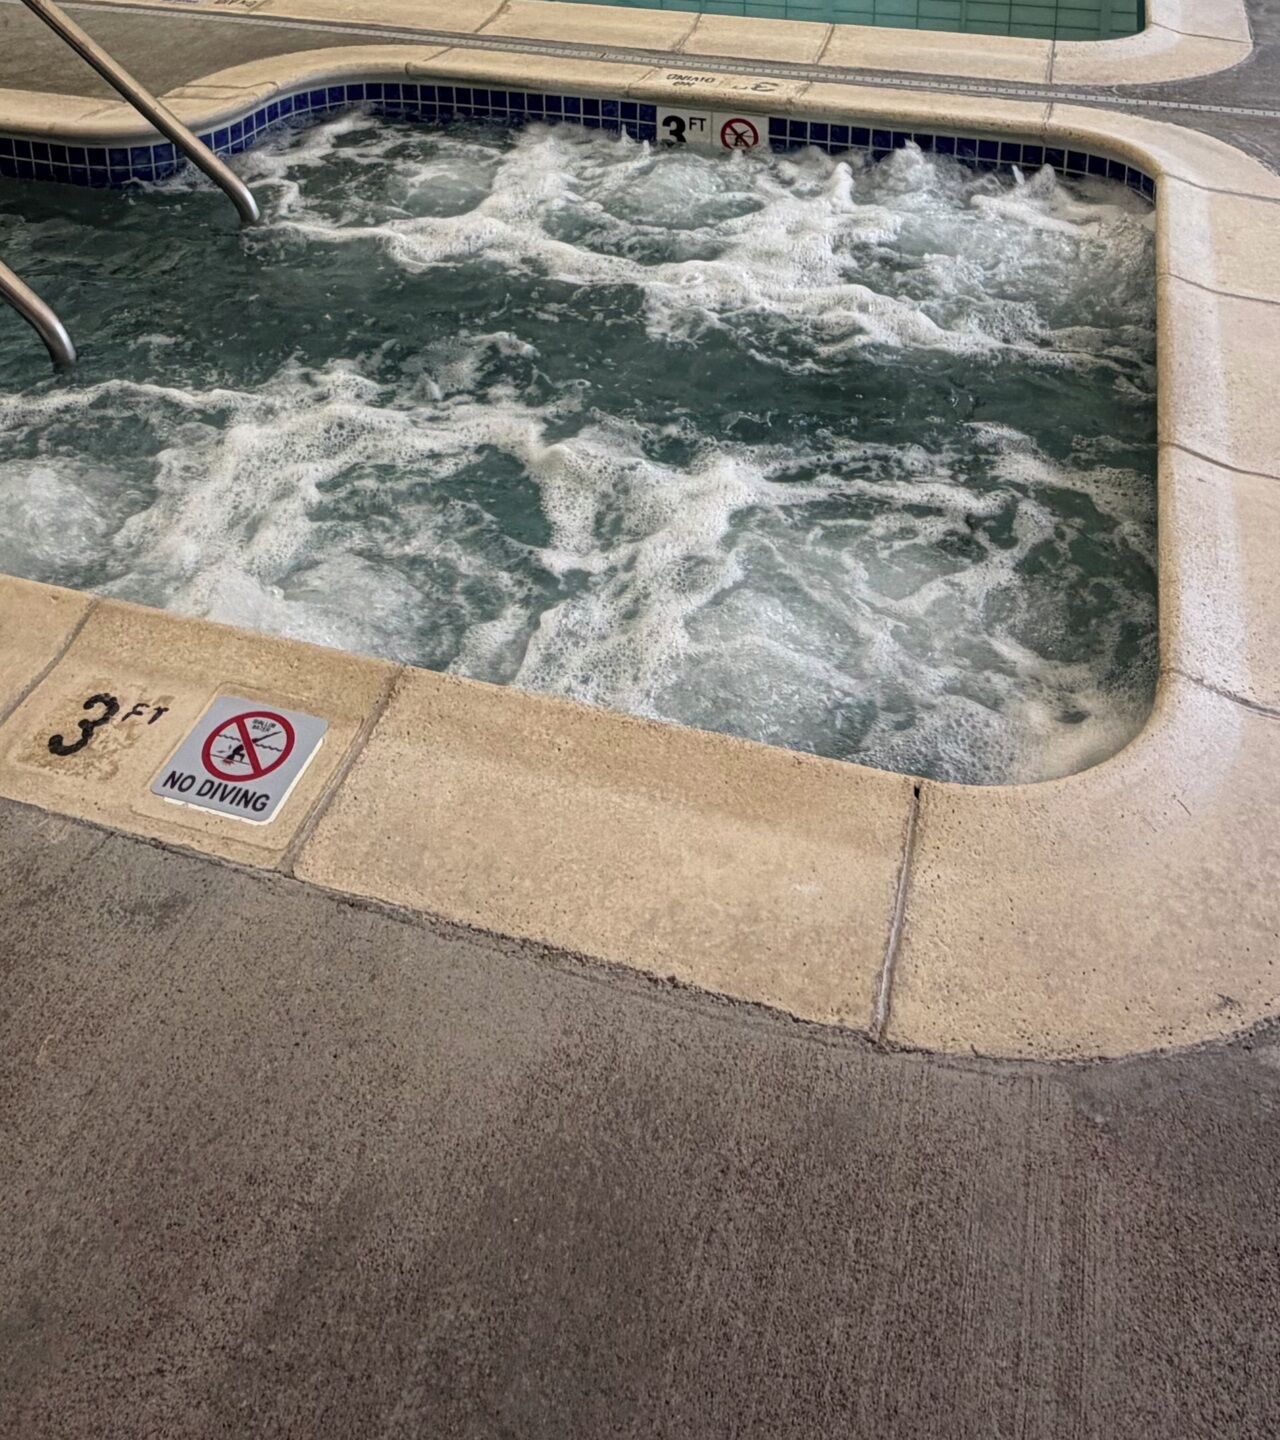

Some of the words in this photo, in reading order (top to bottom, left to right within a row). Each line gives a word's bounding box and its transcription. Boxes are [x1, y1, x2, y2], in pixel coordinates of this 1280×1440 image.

[662, 115, 686, 142] 3
[689, 117, 706, 131] FT
[48, 693, 120, 756] 3
[121, 703, 170, 725] FT
[162, 771, 196, 793] NO
[195, 779, 270, 812] DIVING
